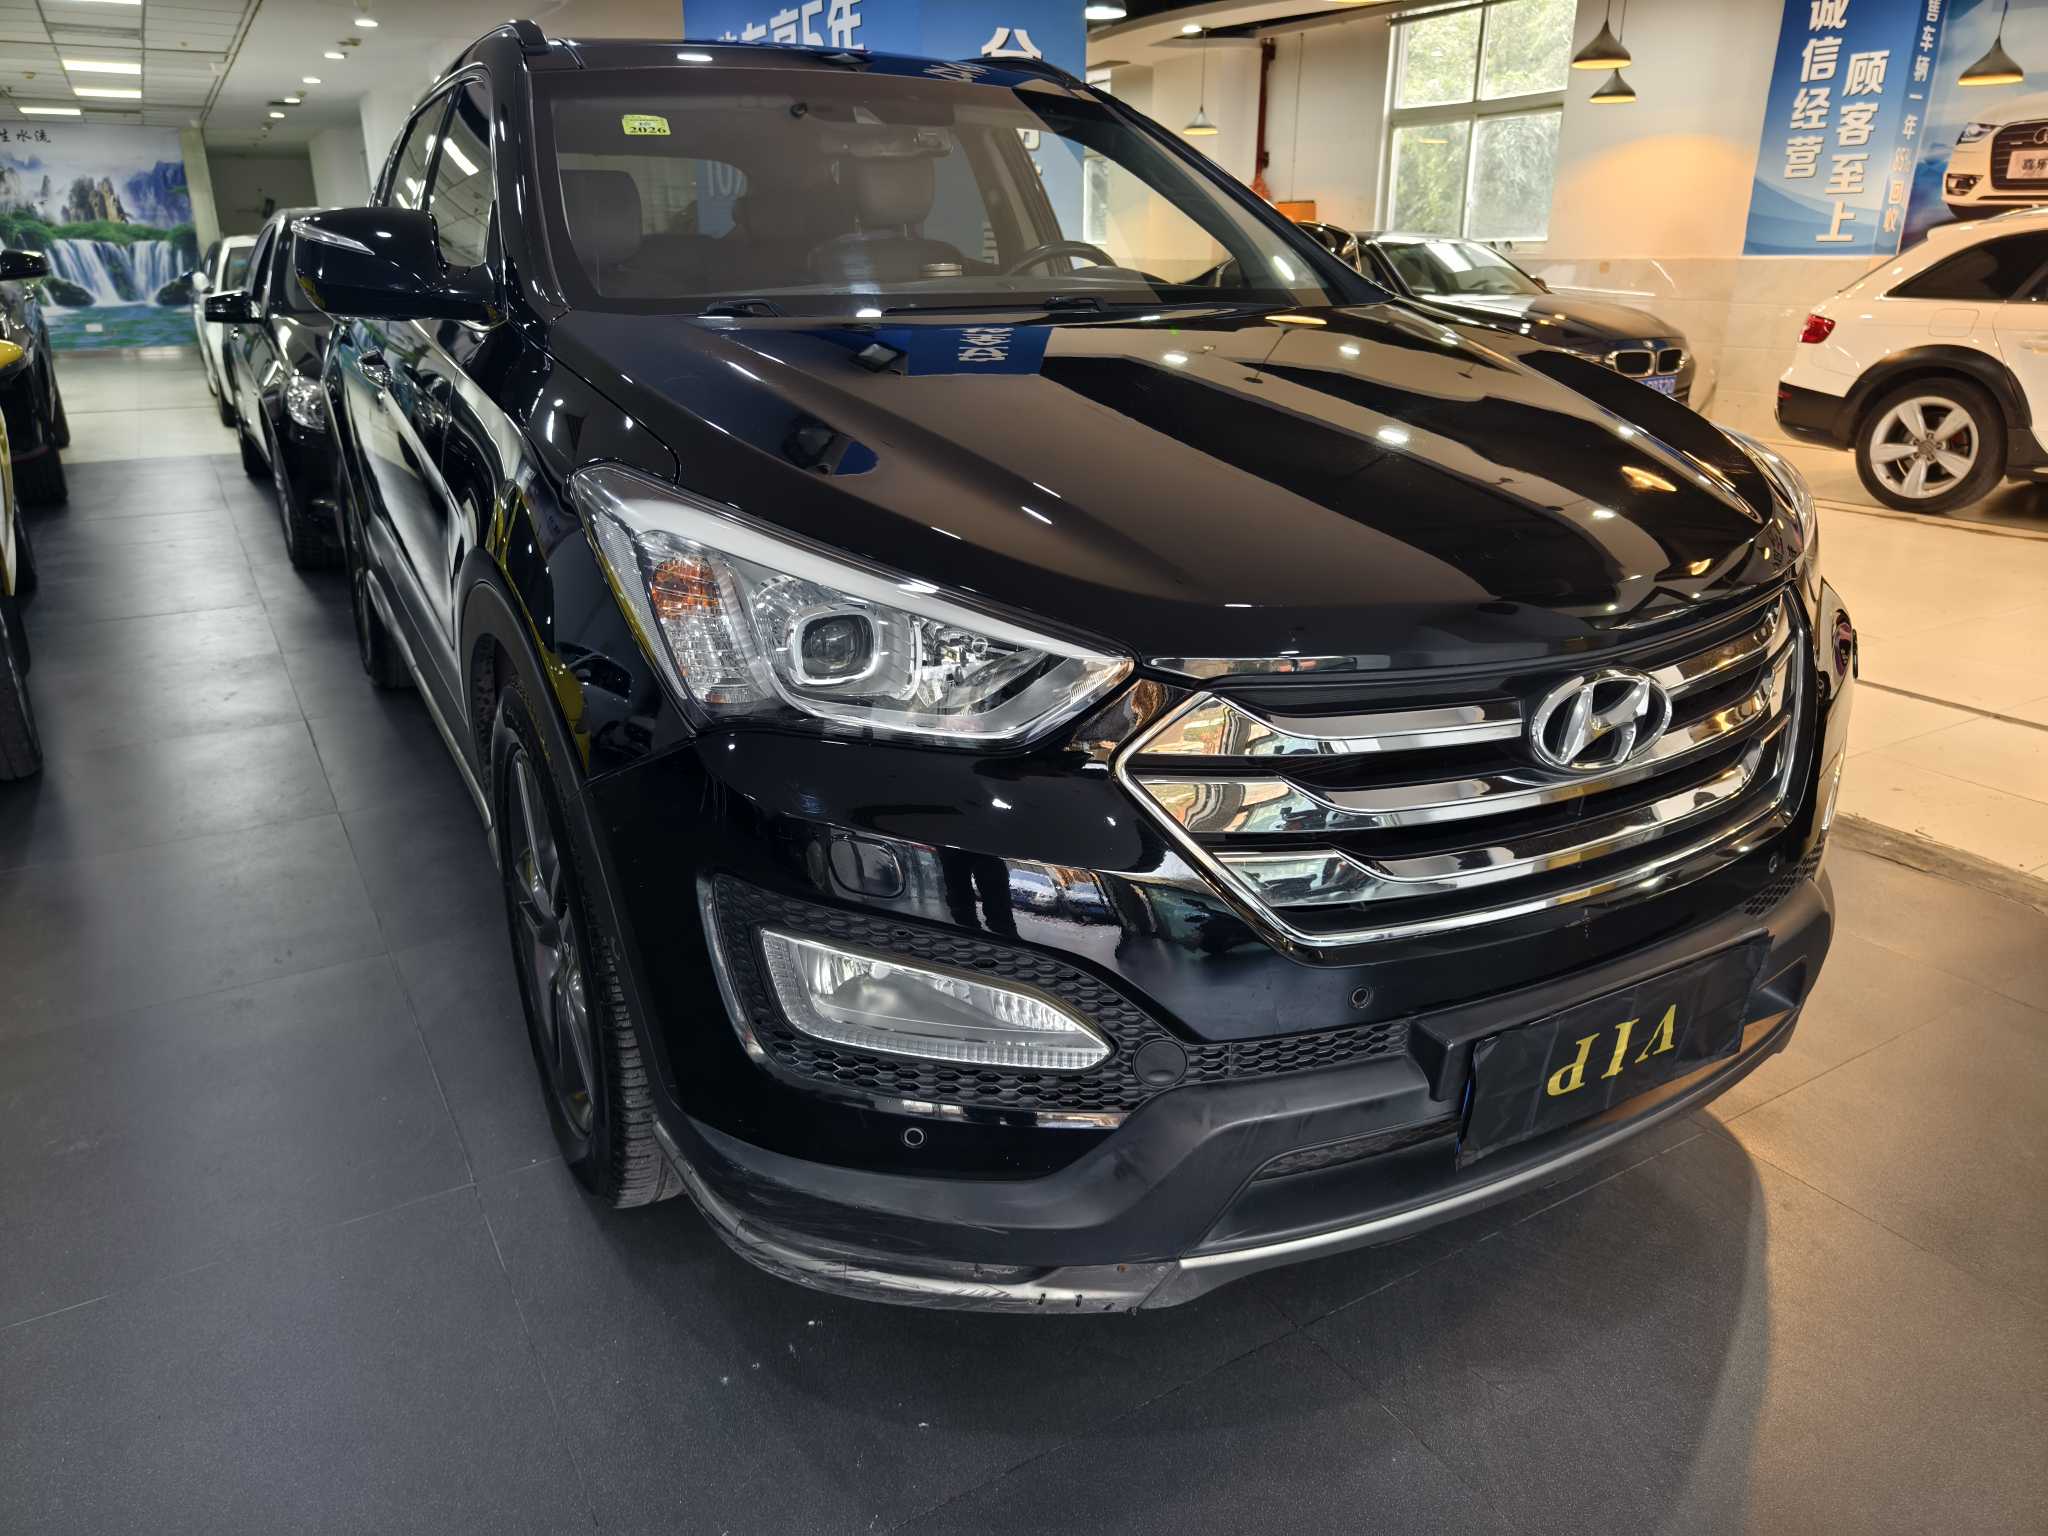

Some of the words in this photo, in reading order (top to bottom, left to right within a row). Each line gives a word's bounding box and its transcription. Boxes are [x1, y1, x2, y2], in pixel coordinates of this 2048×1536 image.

[628, 126, 667, 134] 2026
[1784, 0, 1849, 180] 诚信经营
[1815, 49, 1890, 242] 顾客至上
[1546, 1003, 1677, 1096] VIP
